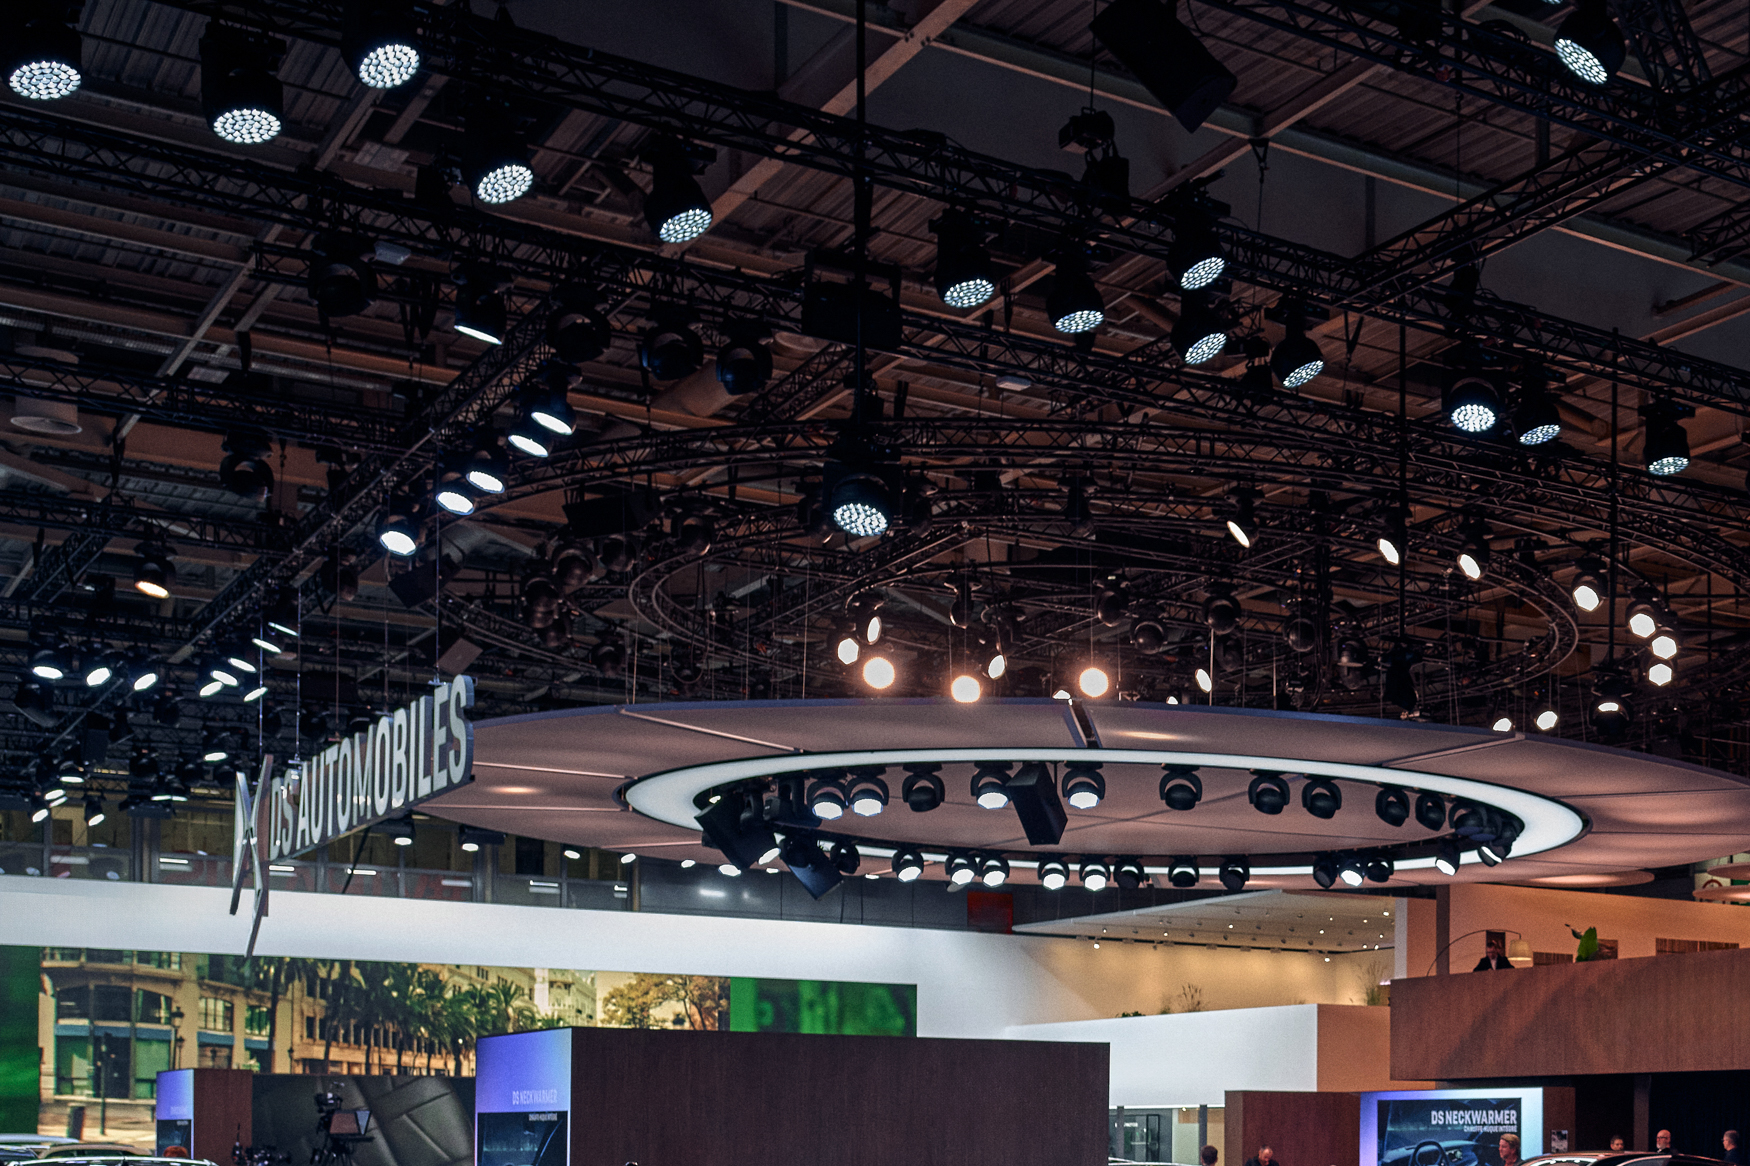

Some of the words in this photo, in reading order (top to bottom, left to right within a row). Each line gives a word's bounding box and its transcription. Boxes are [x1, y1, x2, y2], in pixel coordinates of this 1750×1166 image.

[270, 768, 298, 862] DS
[296, 674, 473, 850] AUTOMOBILES
[1430, 1110, 1444, 1125] DS
[1445, 1109, 1517, 1125] NECKWARMER
